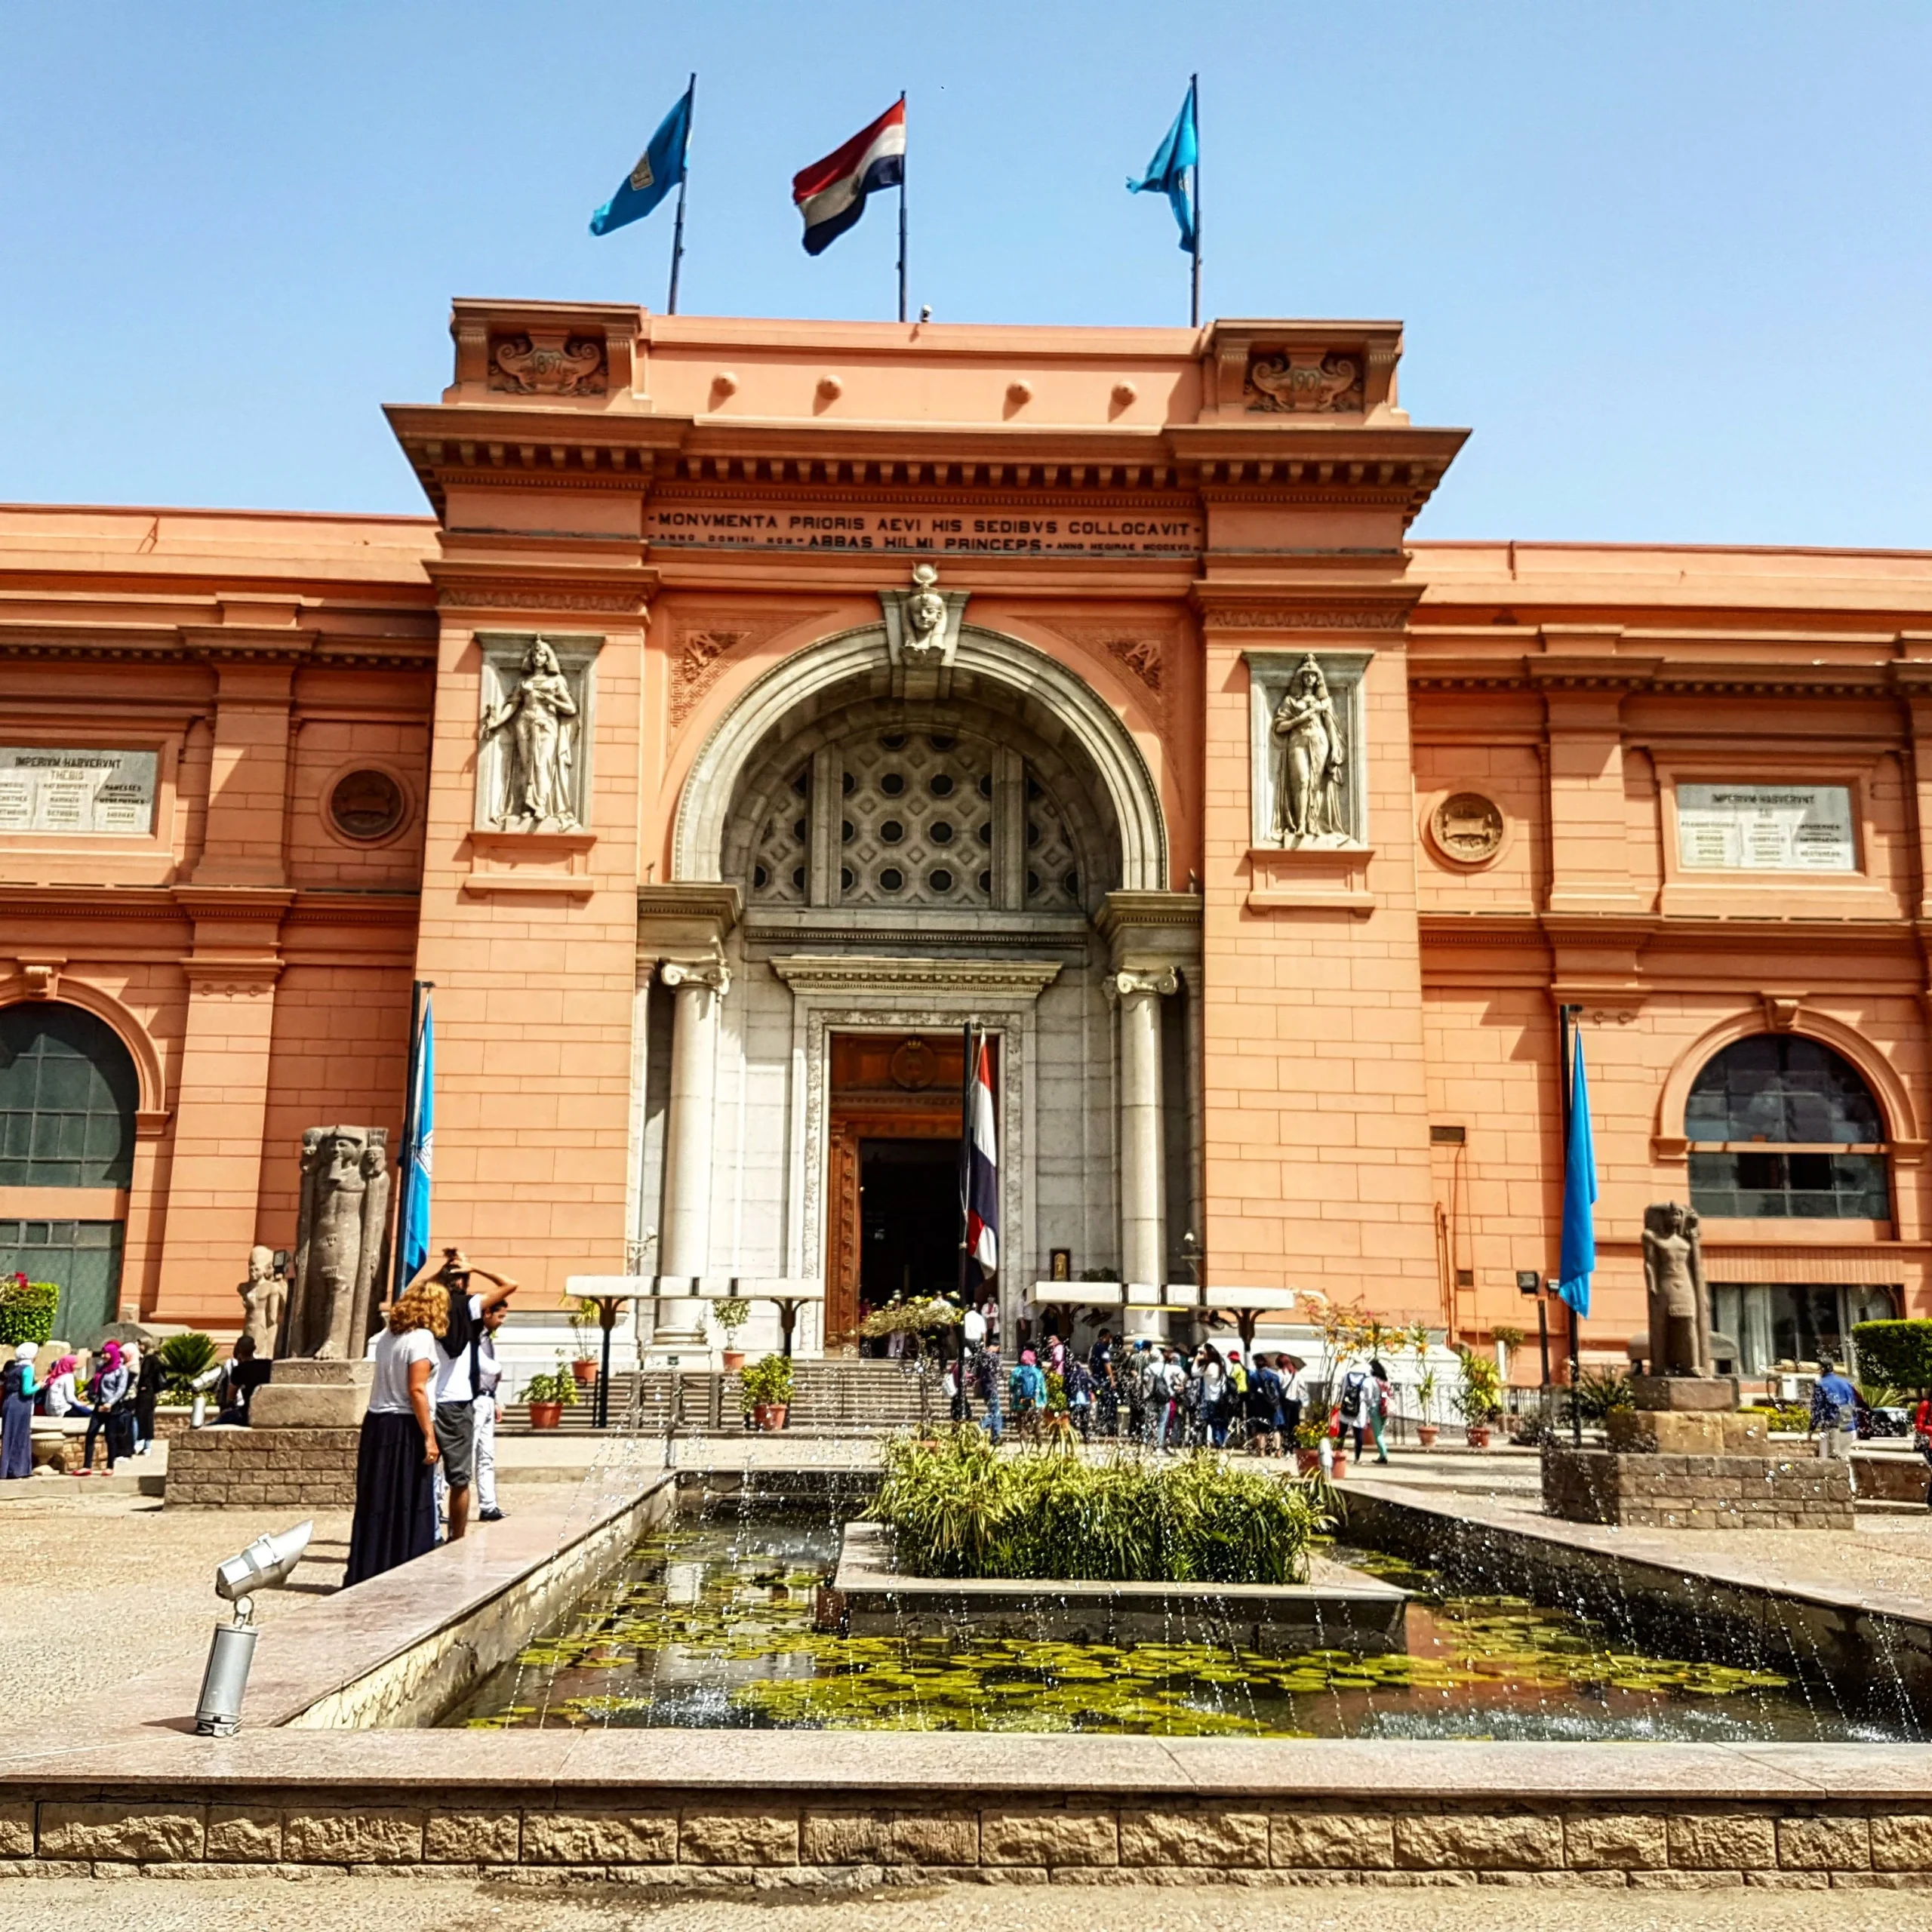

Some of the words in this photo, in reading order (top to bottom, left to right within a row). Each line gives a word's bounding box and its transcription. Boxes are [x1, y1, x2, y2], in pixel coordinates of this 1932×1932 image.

[659, 512, 777, 528] MONVMENTA
[789, 516, 864, 531] PRIORIS
[877, 518, 921, 531] AEVI
[932, 519, 962, 533] HIS
[974, 520, 1057, 534] SEDIBVS
[1069, 521, 1189, 536] COLLOCAVIT
[809, 535, 872, 547] ABBAS
[884, 536, 934, 549] HILMI
[945, 537, 1041, 551] PRINCEPS
